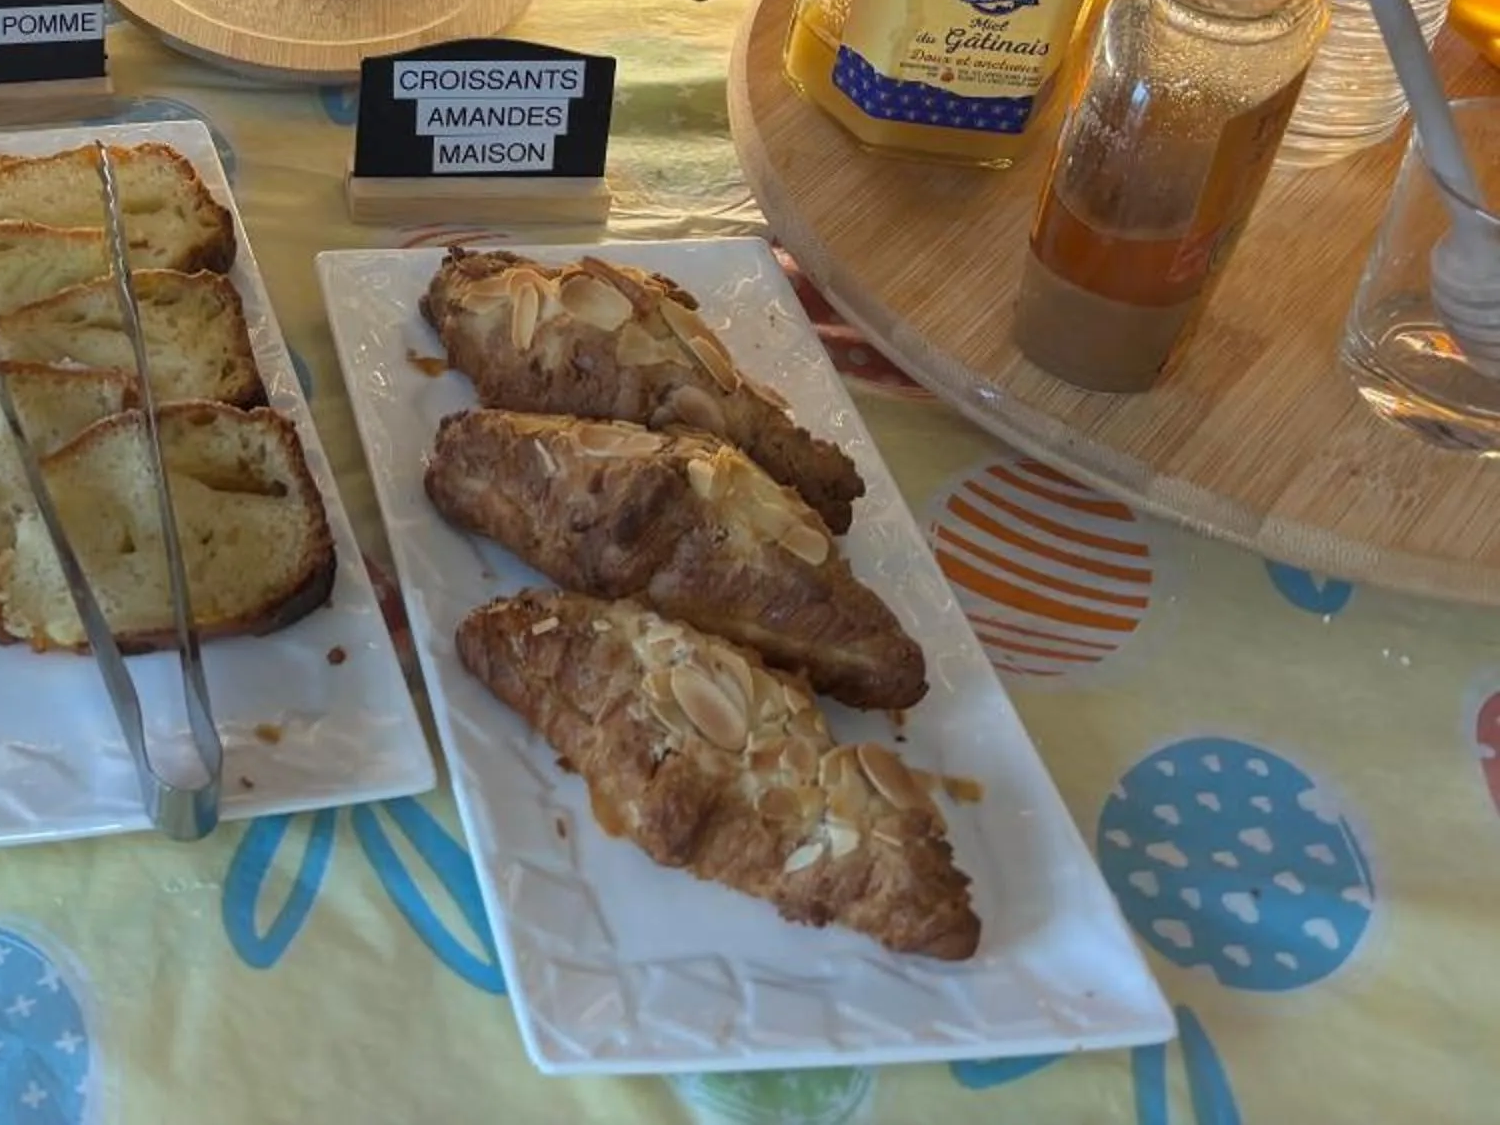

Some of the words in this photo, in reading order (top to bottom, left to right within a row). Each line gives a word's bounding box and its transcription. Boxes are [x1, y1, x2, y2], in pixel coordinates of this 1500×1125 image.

[2, 11, 97, 38] POMME
[945, 27, 1050, 57] Gâtinais
[398, 67, 579, 92] CROISSANTS
[426, 104, 563, 128] AMANDES
[438, 141, 546, 166] MAISON
